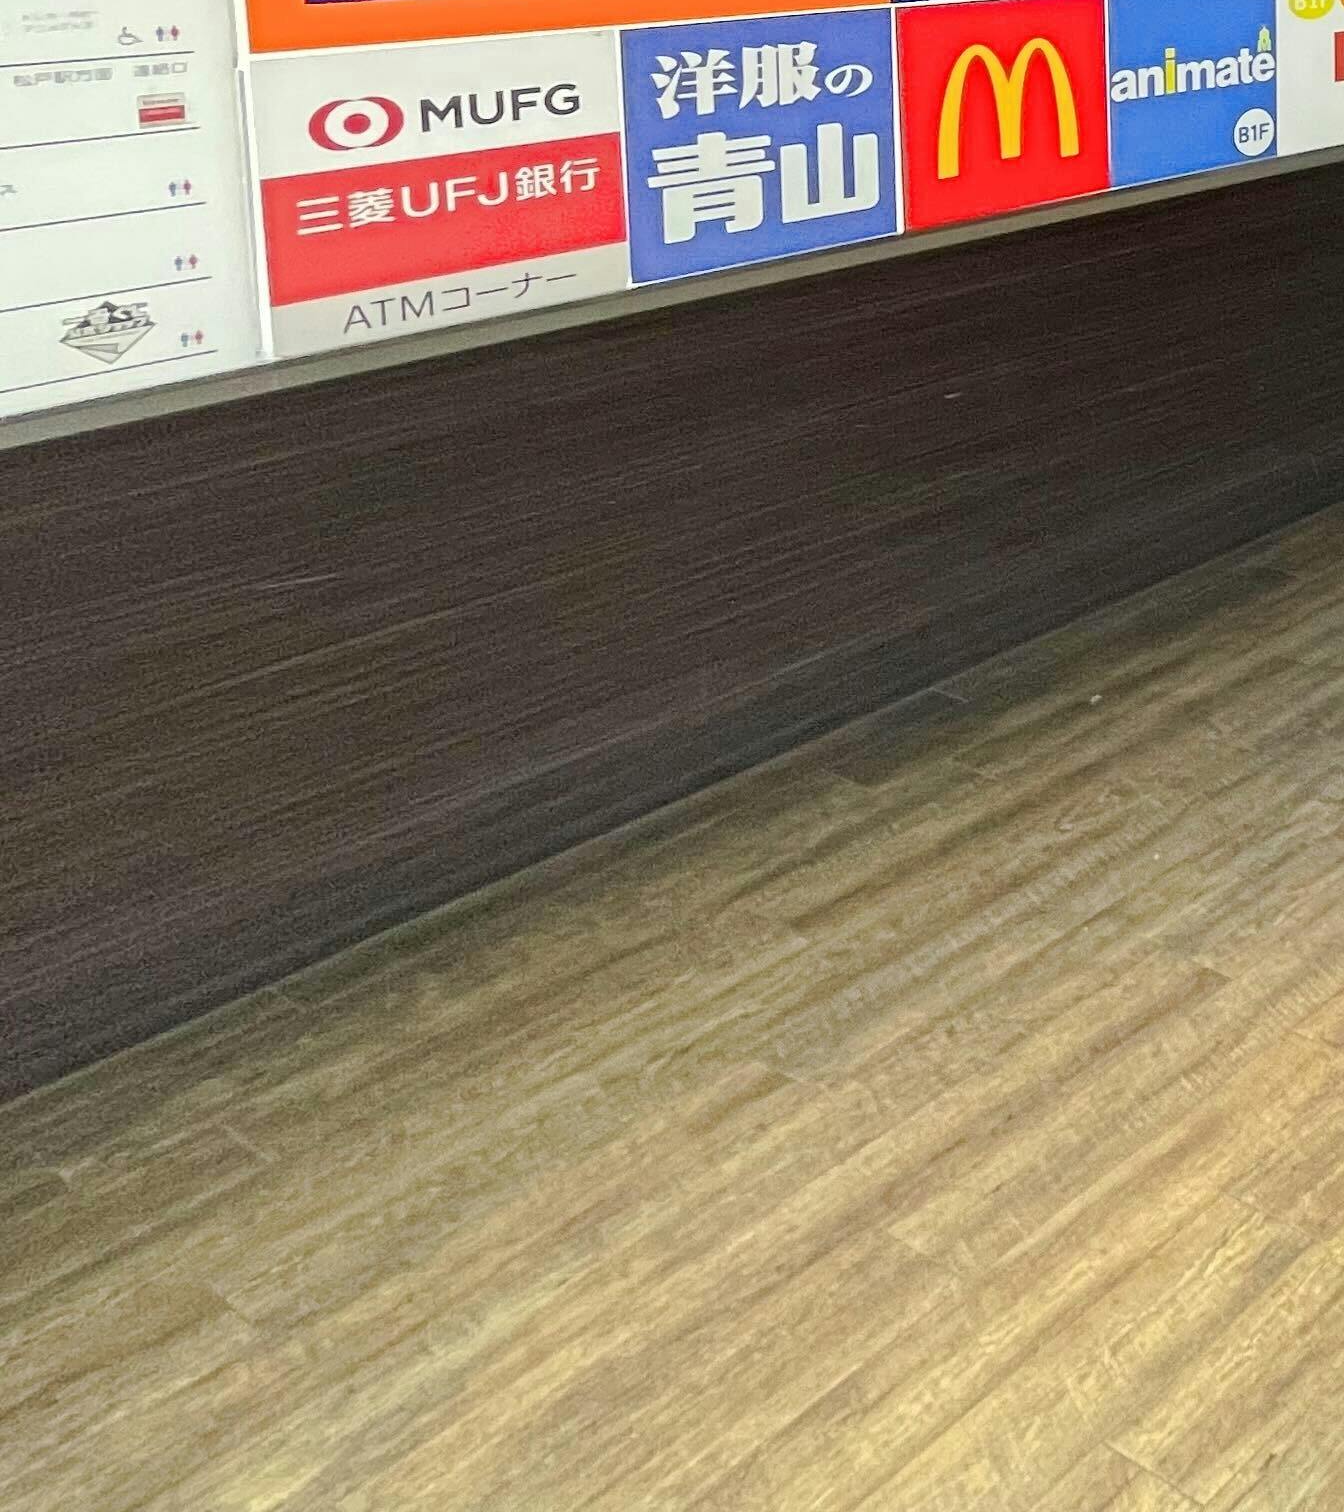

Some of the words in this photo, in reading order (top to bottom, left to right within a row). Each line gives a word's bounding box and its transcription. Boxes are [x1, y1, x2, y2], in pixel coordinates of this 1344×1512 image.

[649, 42, 873, 120] 洋服の
[1110, 45, 1276, 102] animate
[419, 83, 580, 132] MUFG
[1237, 122, 1270, 144] B1F
[296, 158, 600, 235] 三菱UFJ銀行
[647, 123, 880, 244] 青山
[344, 272, 576, 334] ATMコーナー
